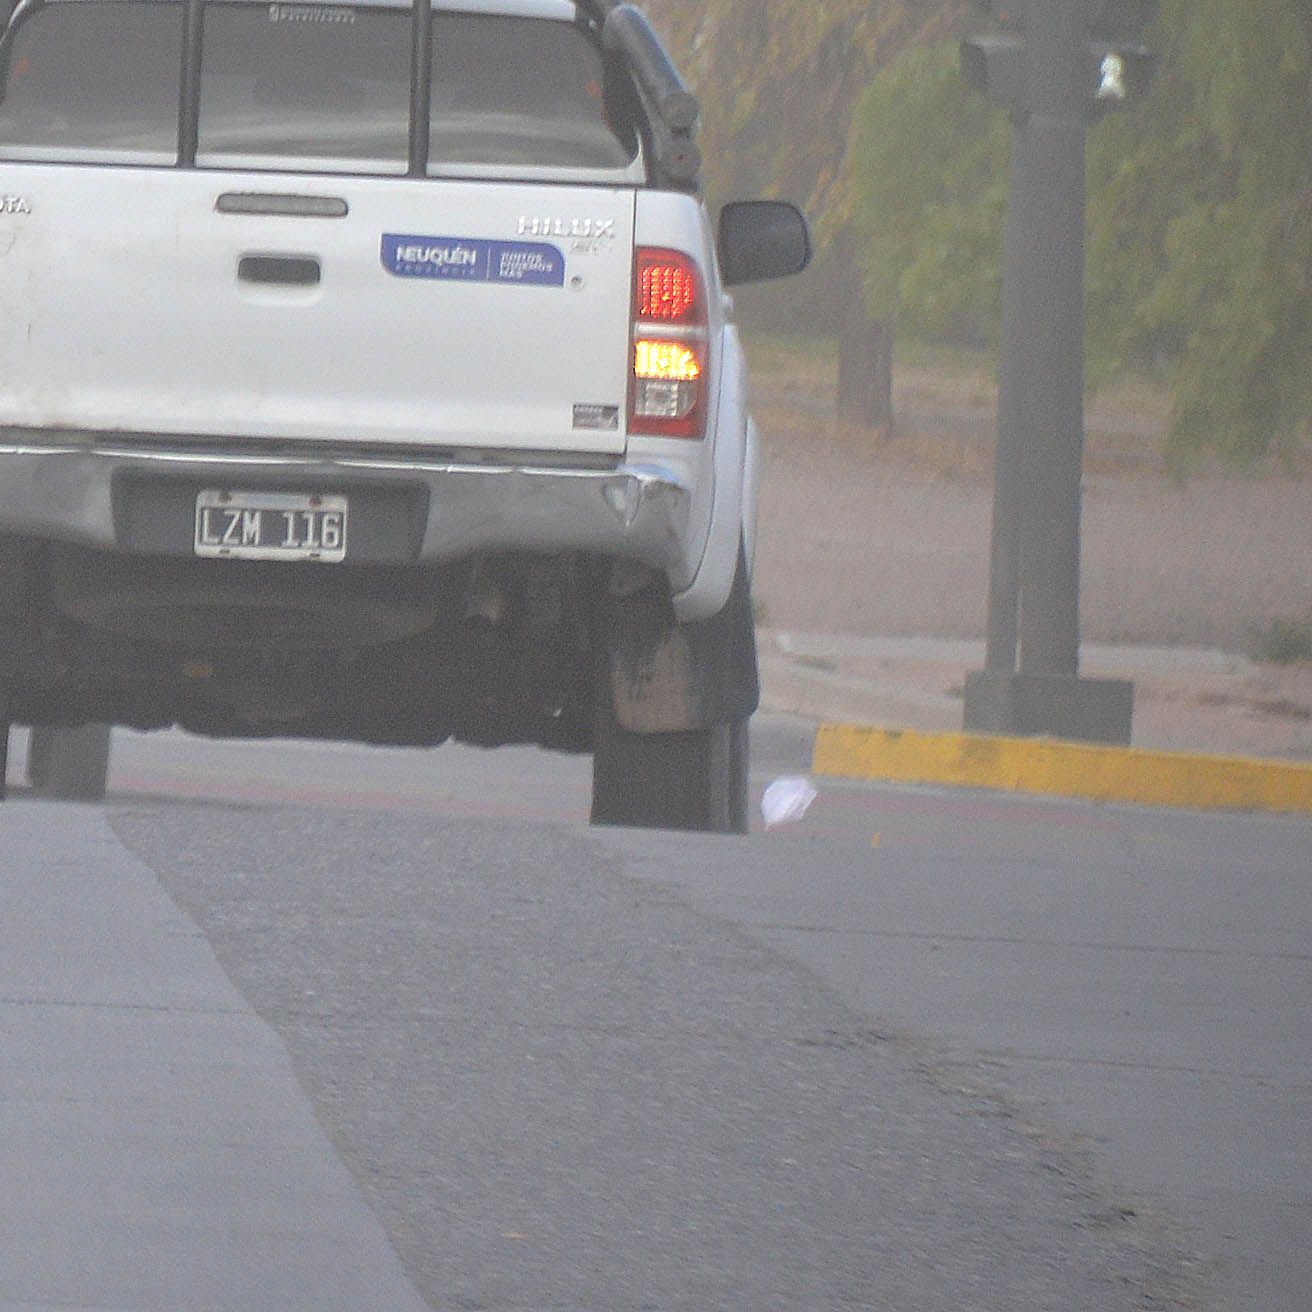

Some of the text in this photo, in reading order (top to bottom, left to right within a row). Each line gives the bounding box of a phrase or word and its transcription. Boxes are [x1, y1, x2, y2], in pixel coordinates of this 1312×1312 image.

[517, 215, 616, 239] HILUX
[396, 244, 477, 266] NEUQUÉN
[202, 509, 340, 548] LZM 116
